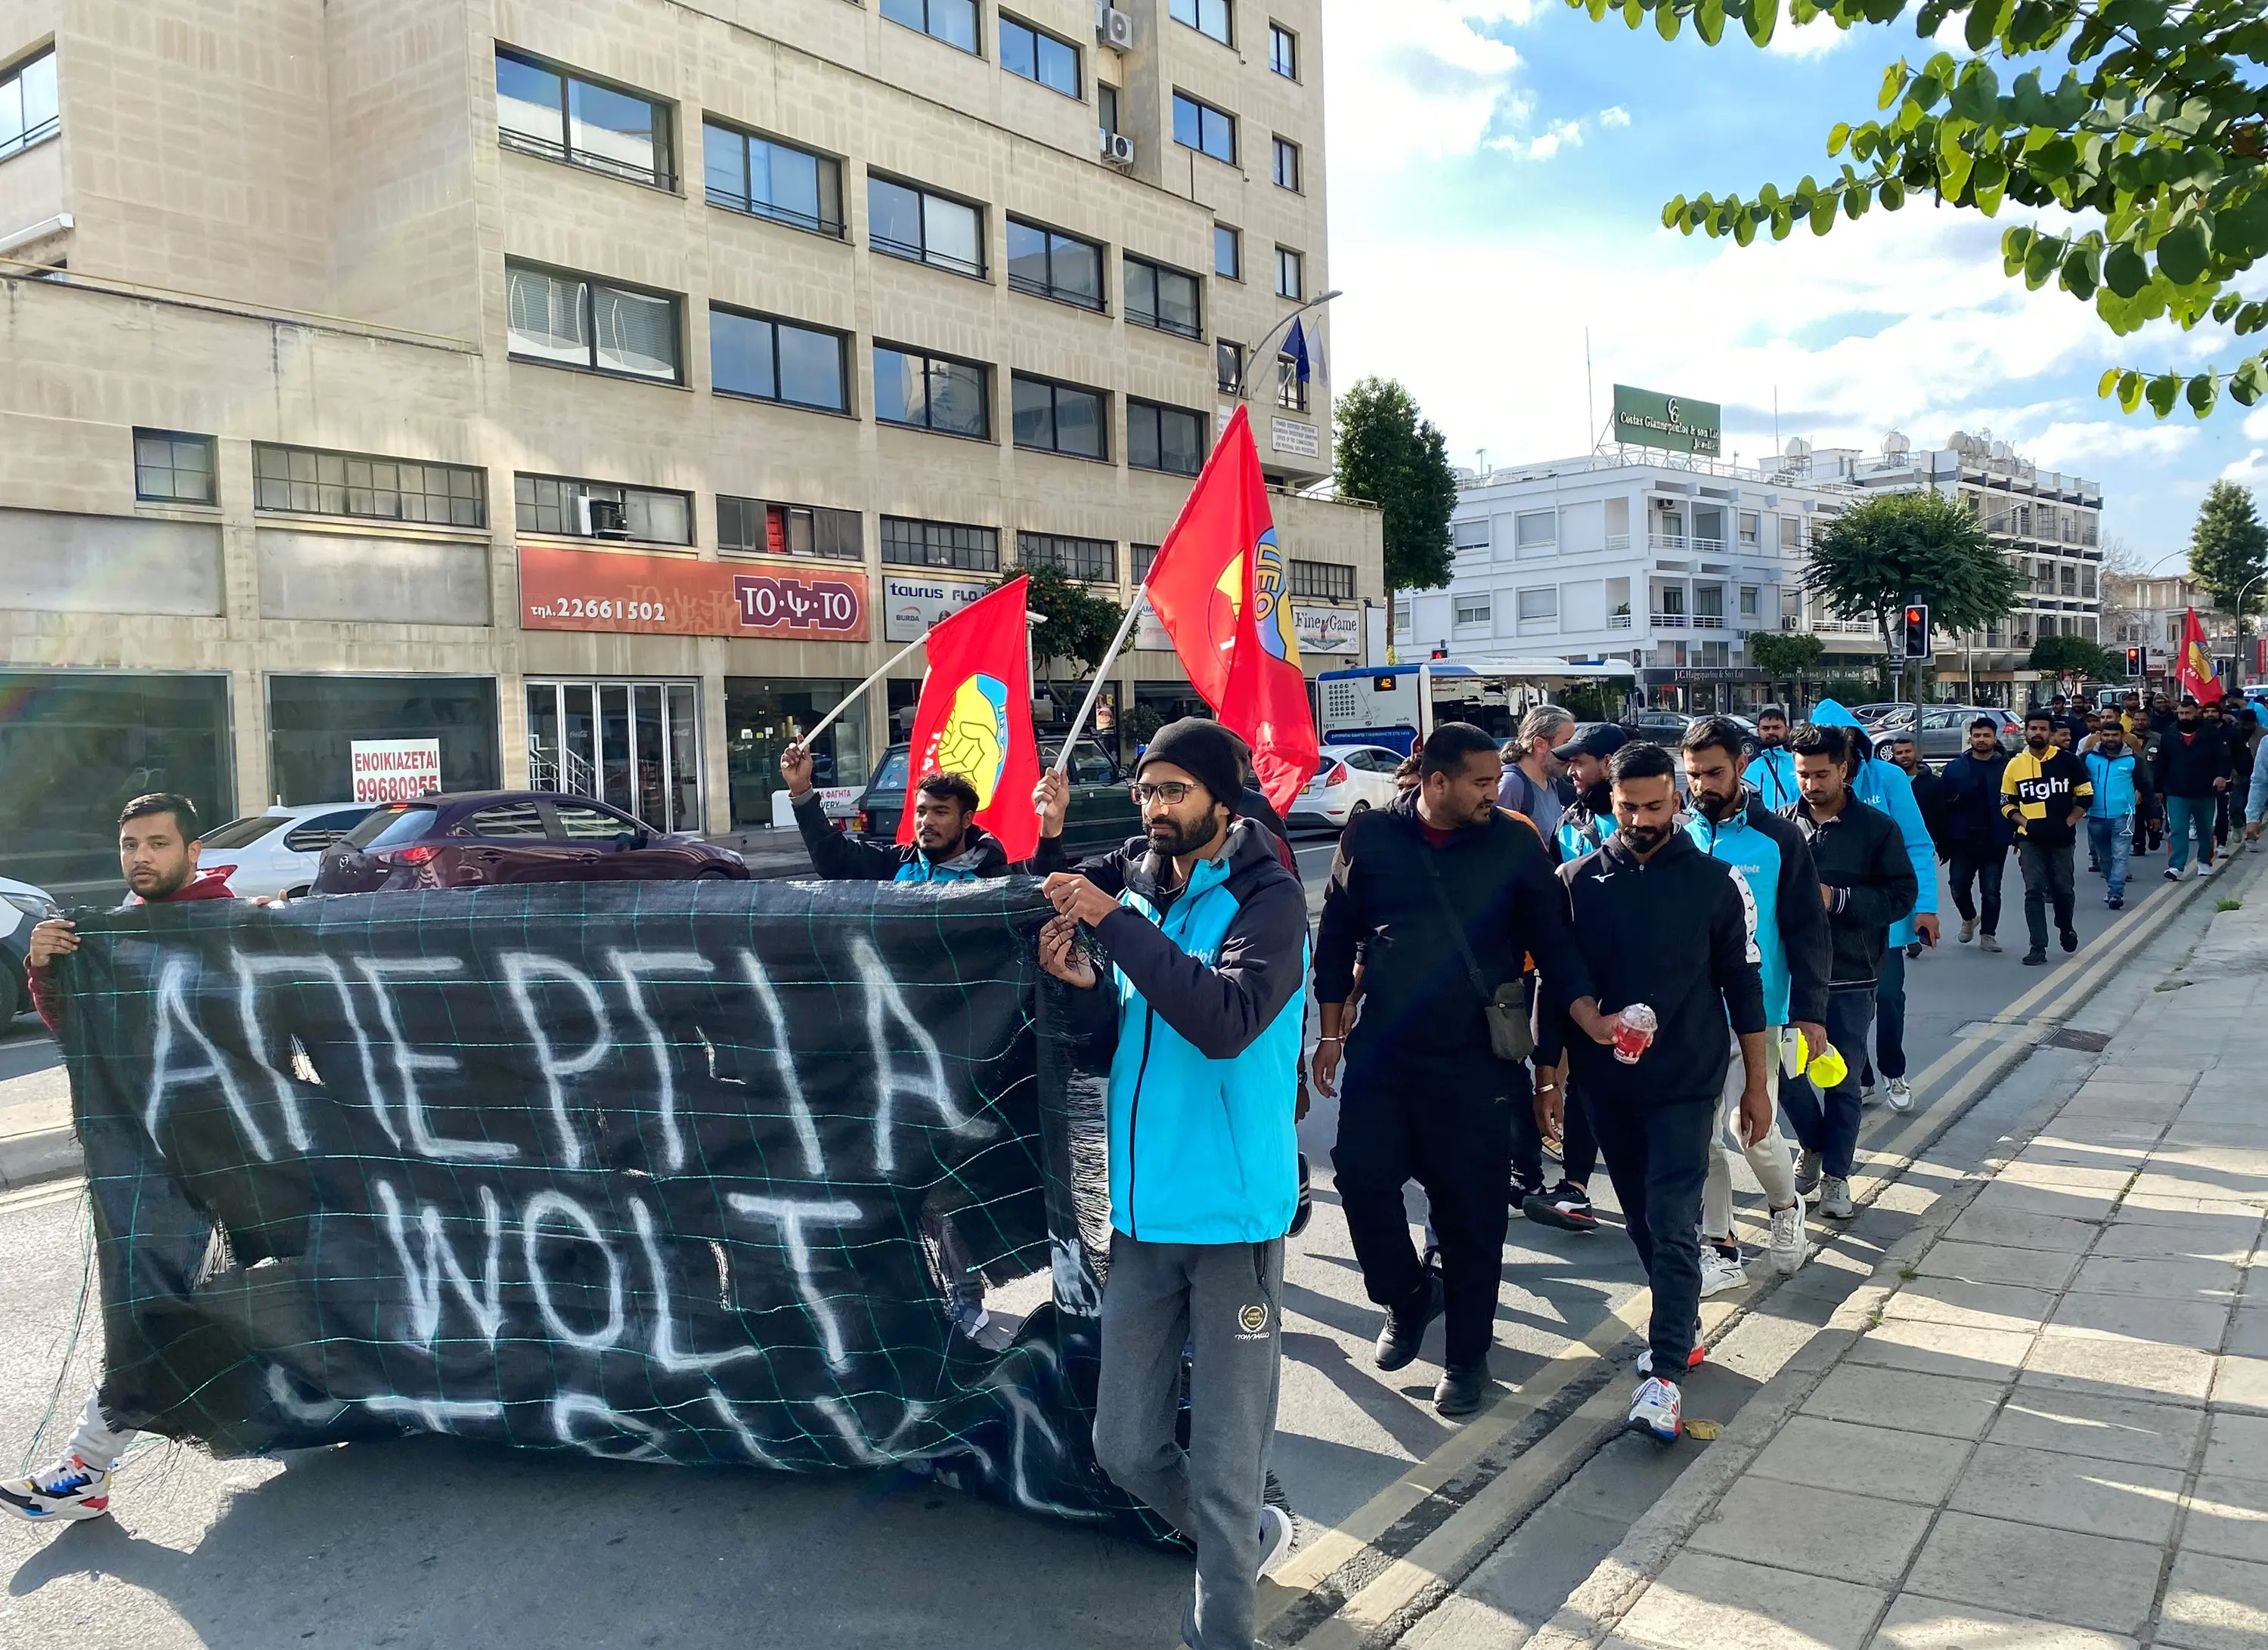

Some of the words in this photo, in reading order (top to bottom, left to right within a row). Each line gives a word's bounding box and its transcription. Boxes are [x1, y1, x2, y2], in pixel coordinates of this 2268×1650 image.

[1620, 411, 1644, 426] Costas
[890, 582, 943, 599] taurus
[531, 605, 556, 619] τηλ.
[557, 597, 665, 621] 22661502
[896, 614, 920, 622] BURDA
[1295, 611, 1321, 629] Fine
[1330, 614, 1357, 631] Game
[355, 751, 438, 772] ΕΝΟΙΚΙΑΖΕΤΑΙ
[357, 775, 438, 802] 99680955
[826, 790, 851, 799] ΦΑΓΗΤΑ
[2019, 777, 2069, 800] Fight
[144, 933, 998, 1178] ΑΠΕΡΓΙΑ
[374, 1175, 862, 1376] WOLT
